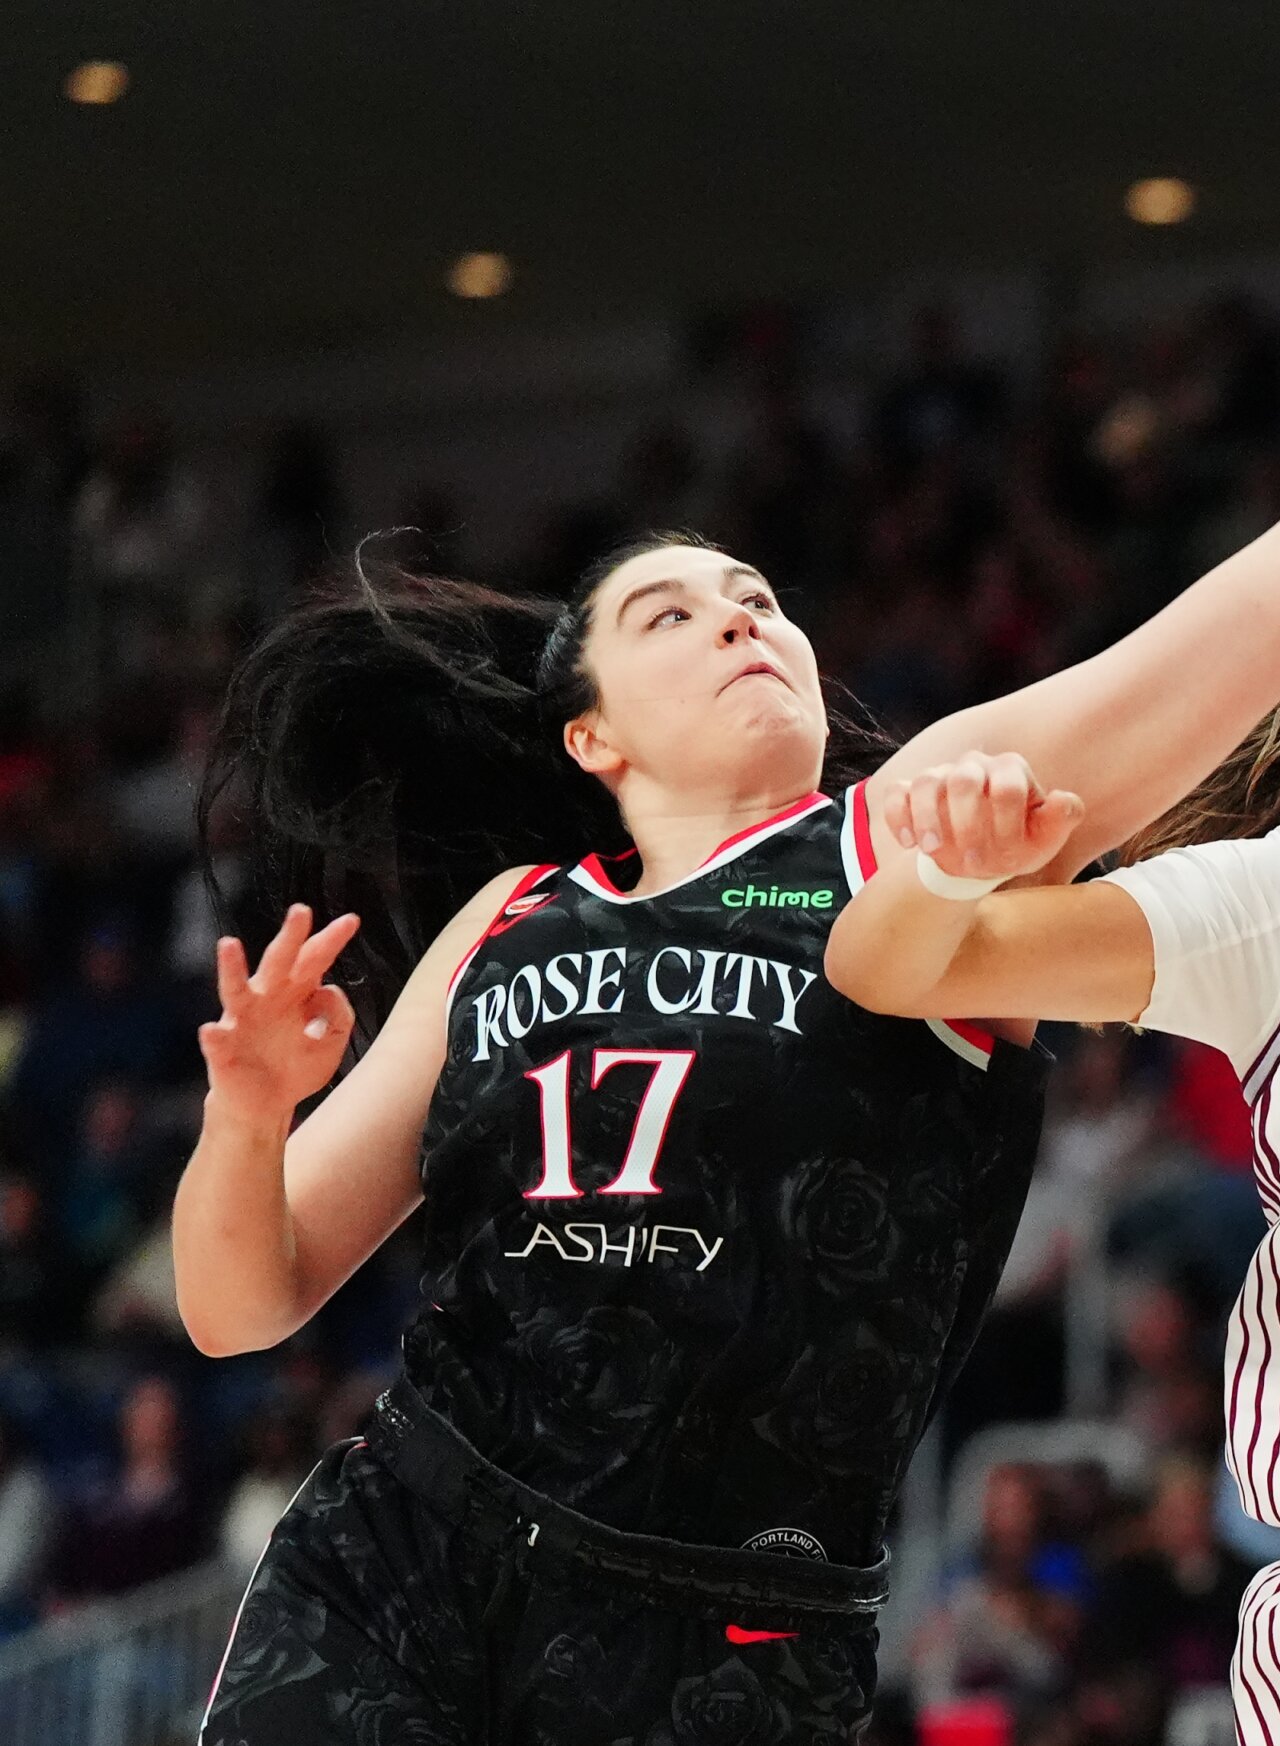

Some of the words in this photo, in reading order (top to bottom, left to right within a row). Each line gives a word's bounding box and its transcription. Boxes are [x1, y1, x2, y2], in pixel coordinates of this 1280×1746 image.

[721, 885, 833, 909] chime
[471, 947, 627, 1063] ROSE
[646, 946, 818, 1036] CITY
[522, 1048, 696, 1199] 17
[504, 1222, 724, 1271] ASHIFY
[751, 1532, 813, 1552] PORTLAND
